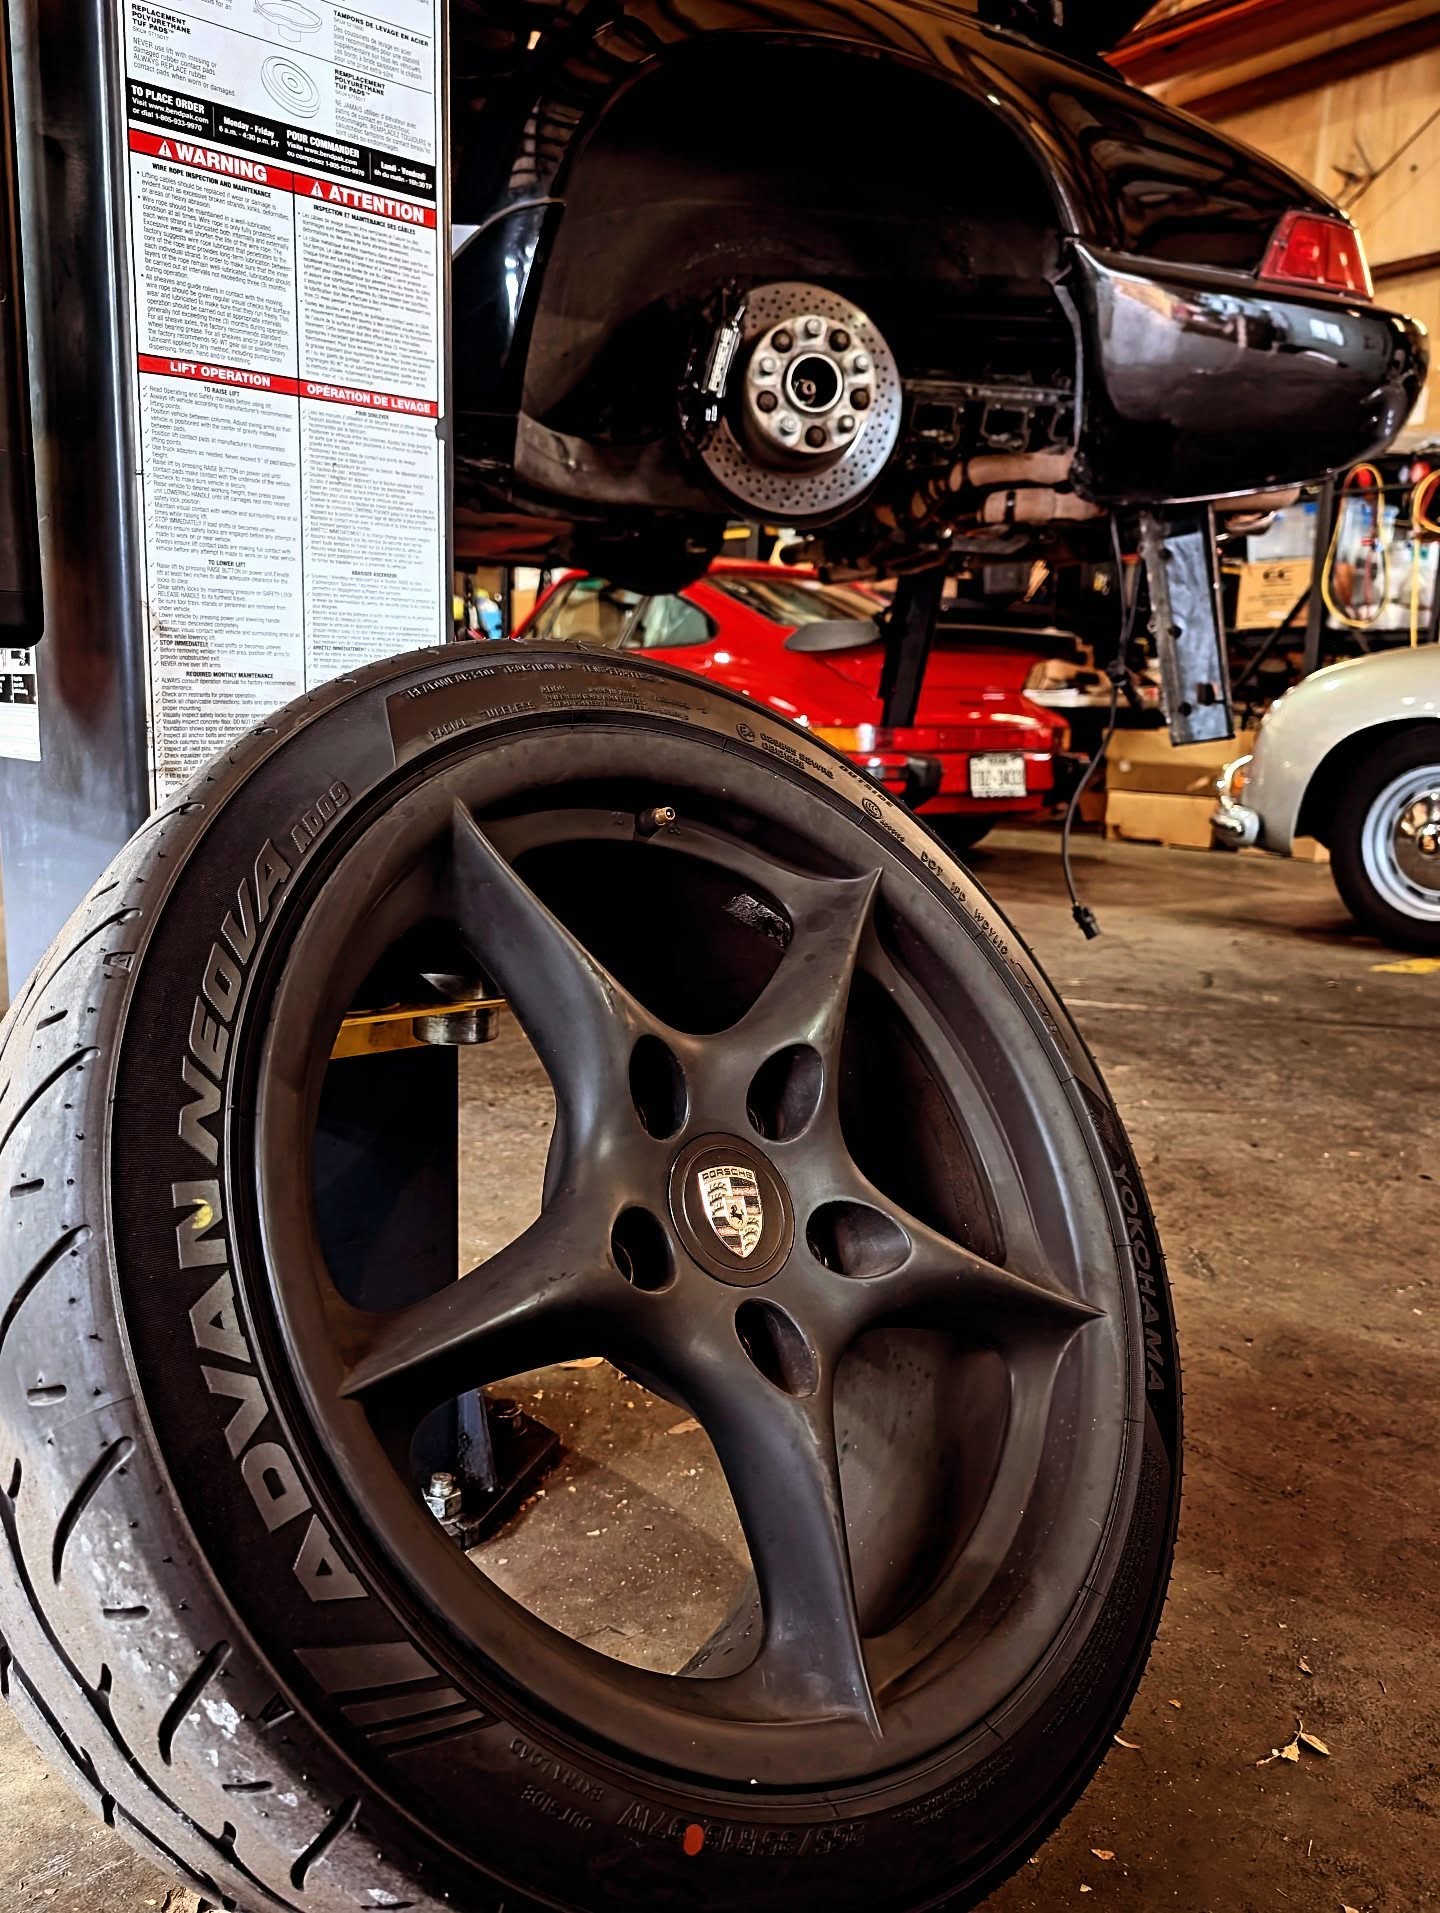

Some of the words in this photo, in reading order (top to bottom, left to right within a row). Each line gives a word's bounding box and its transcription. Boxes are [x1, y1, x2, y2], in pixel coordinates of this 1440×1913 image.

[132, 4, 185, 25] REPLACEMENT
[132, 11, 190, 34] POLYURETHANE
[132, 18, 146, 28] TUF
[334, 10, 363, 25] TAMPONS
[375, 24, 398, 36] LEVAGE
[410, 35, 428, 46] ACIER
[134, 38, 153, 49] NEVER
[174, 51, 186, 59] with
[188, 54, 209, 67] missing
[134, 46, 159, 58] damaged
[160, 54, 178, 64] rubber
[180, 60, 200, 71] contact
[202, 67, 215, 75] pads
[134, 53, 158, 66] ALWAYS
[160, 61, 186, 74] REPLACE
[188, 70, 206, 80] rubber
[134, 62, 154, 72] contact
[156, 69, 169, 77] pads
[171, 73, 186, 82] when
[187, 78, 201, 86] worn
[210, 83, 236, 96] damaged.
[335, 69, 385, 89] REMPLACEMENT
[335, 82, 346, 90] TUF
[132, 85, 142, 98] TO
[145, 89, 172, 106] PLACE
[175, 97, 204, 114] ORDER
[132, 96, 146, 107] Visit
[148, 102, 208, 124] www.bendpak.com
[141, 109, 153, 118] dial
[224, 117, 248, 132] Monday
[254, 125, 274, 138] Friday
[242, 132, 255, 141] 4:30
[270, 139, 279, 148] PT
[287, 129, 307, 144] POUR
[310, 136, 359, 158] COMMANDER
[287, 141, 302, 151] Visite
[304, 147, 357, 166] www.bendpak.com
[176, 143, 266, 184] WARNING
[152, 163, 166, 172] WIRE
[168, 167, 183, 177] ROPE
[185, 171, 218, 185] INSPECTION
[220, 180, 231, 189] AND
[232, 183, 271, 199] MAINTENANCE
[313, 204, 342, 216] INSPECTION
[351, 213, 385, 227] MAINTENANCE
[386, 221, 396, 230] DES
[397, 223, 415, 234] CÂBLES
[329, 185, 424, 224] ATTENTION
[170, 362, 196, 375] LIFT
[200, 366, 270, 386] OPERATION
[307, 383, 370, 403] OPÉRATION
[373, 394, 387, 406] DE
[391, 397, 430, 414] LEVAGE
[290, 780, 351, 854] AD09
[920, 850, 944, 877] DOT
[176, 838, 292, 1166] NEOVA
[701, 1167, 754, 1180] PORSCHE
[1112, 1162, 1166, 1391] YOKOHAMA
[171, 1178, 370, 1602] ADVAN
[508, 1736, 552, 1777] LOAD
